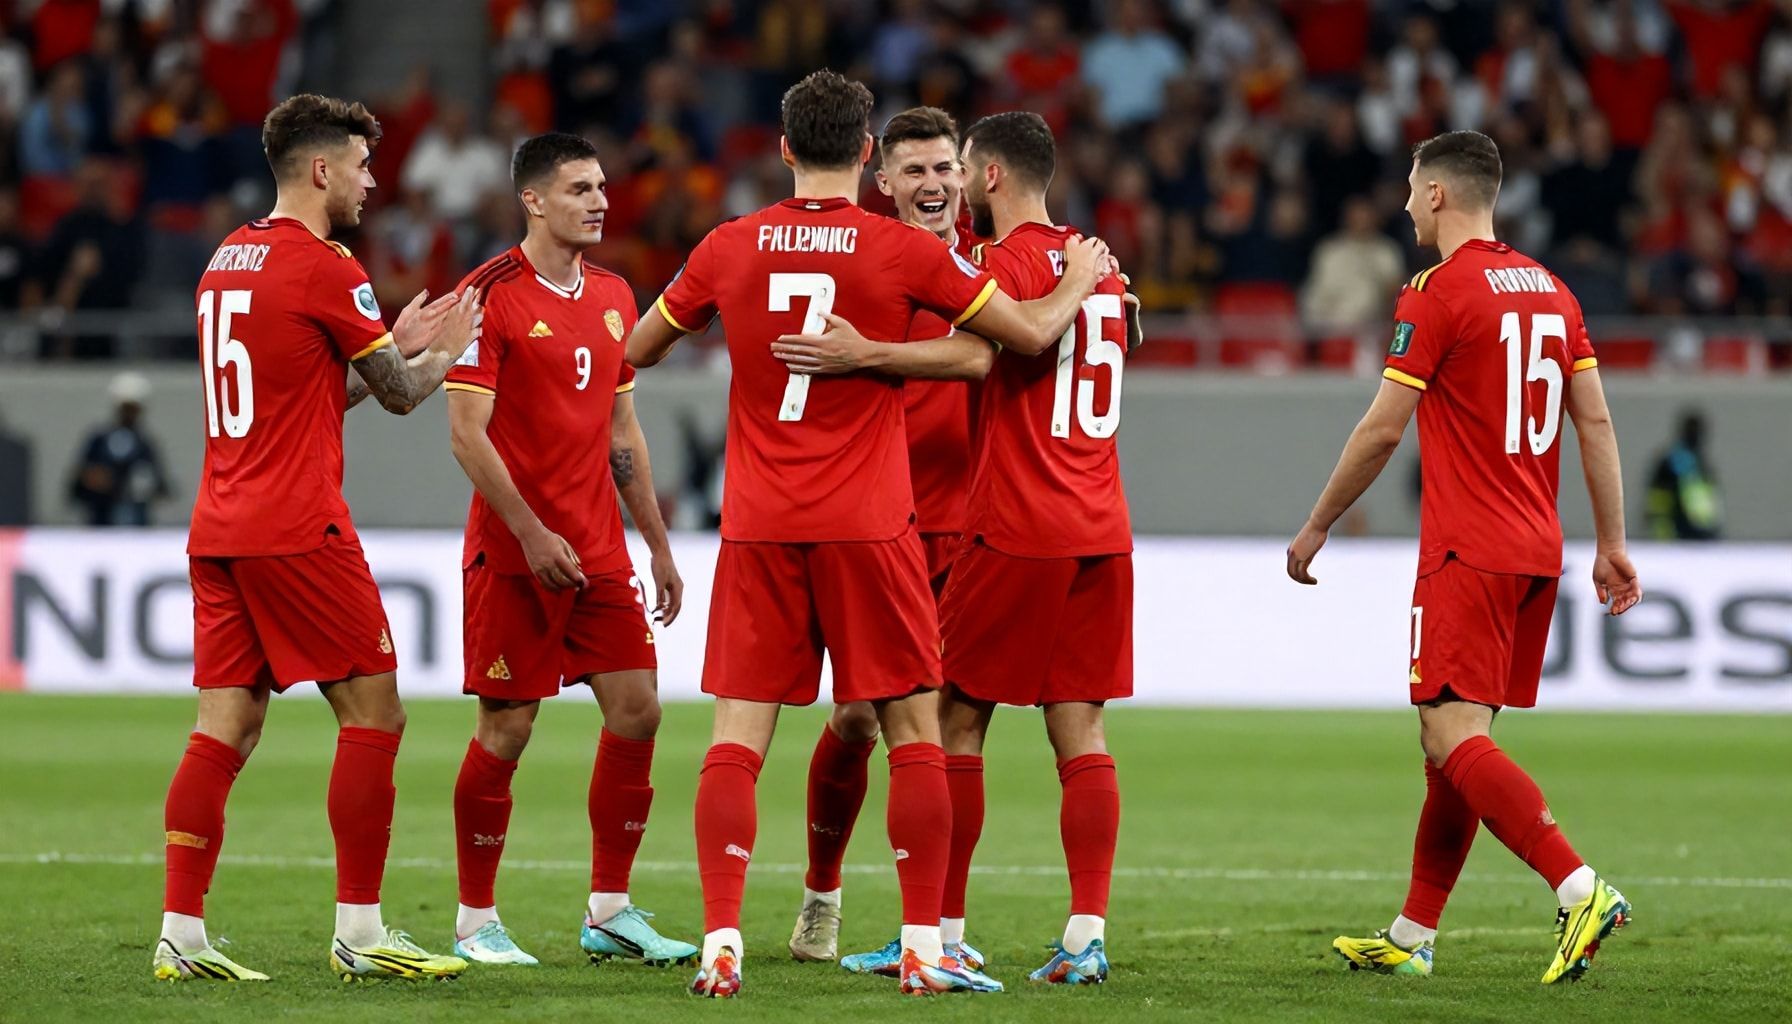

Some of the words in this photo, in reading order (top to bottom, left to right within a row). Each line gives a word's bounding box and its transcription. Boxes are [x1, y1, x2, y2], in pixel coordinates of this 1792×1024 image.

[198, 290, 254, 438] 15
[574, 346, 592, 391] 9
[768, 273, 836, 421] 7
[1051, 293, 1124, 439] 15
[1499, 312, 1567, 456] 15
